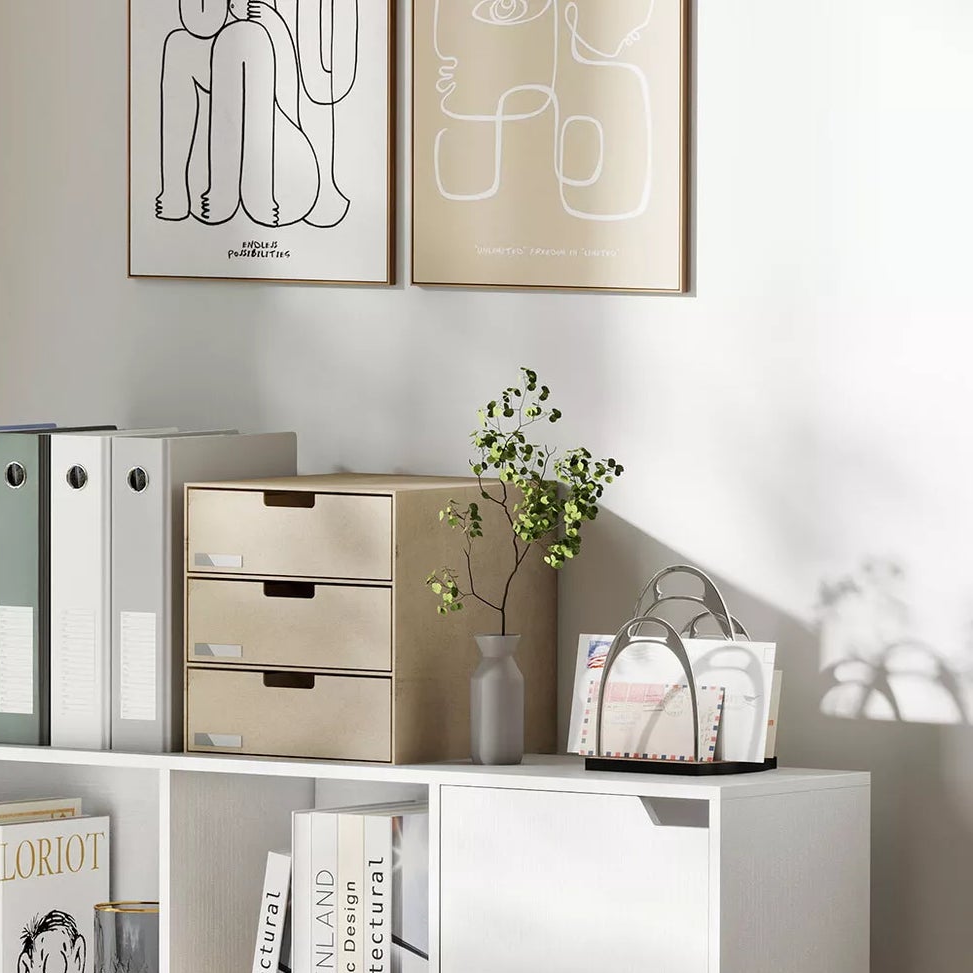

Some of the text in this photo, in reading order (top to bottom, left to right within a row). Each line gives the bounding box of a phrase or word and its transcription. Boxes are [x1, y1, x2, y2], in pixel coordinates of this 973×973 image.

[227, 248, 291, 260] POSSIBILITIES
[242, 240, 278, 249] ENDLESS
[0, 831, 106, 882] LORIOT
[343, 880, 359, 952] Design
